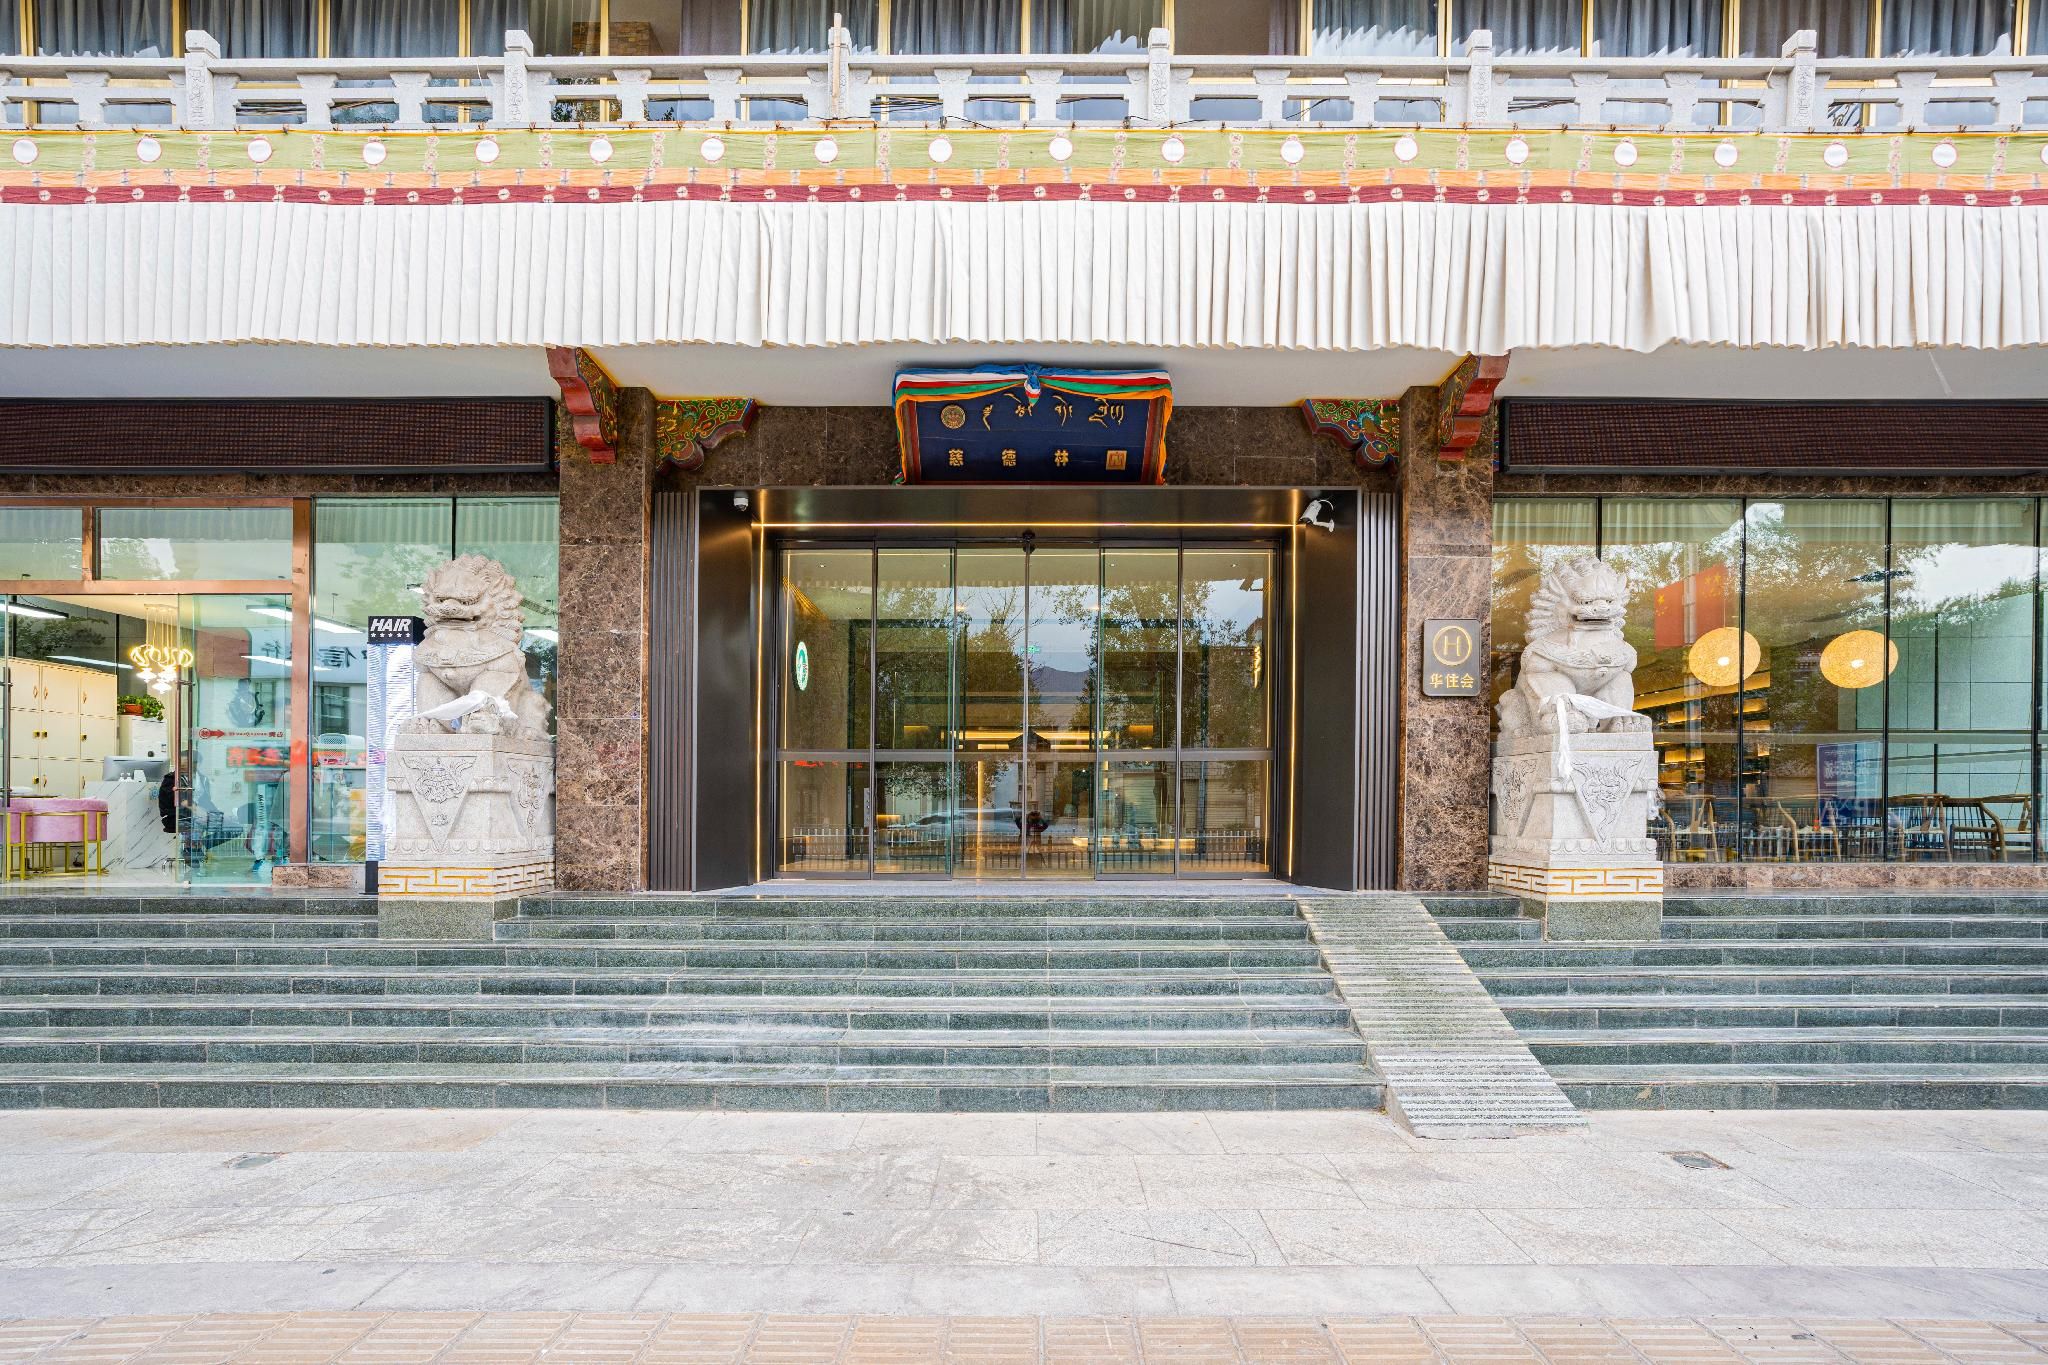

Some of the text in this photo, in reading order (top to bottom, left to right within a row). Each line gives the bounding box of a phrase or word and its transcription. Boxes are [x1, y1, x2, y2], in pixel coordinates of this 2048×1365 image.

[370, 618, 411, 631] HAIR
[1429, 673, 1475, 689] 华住会
